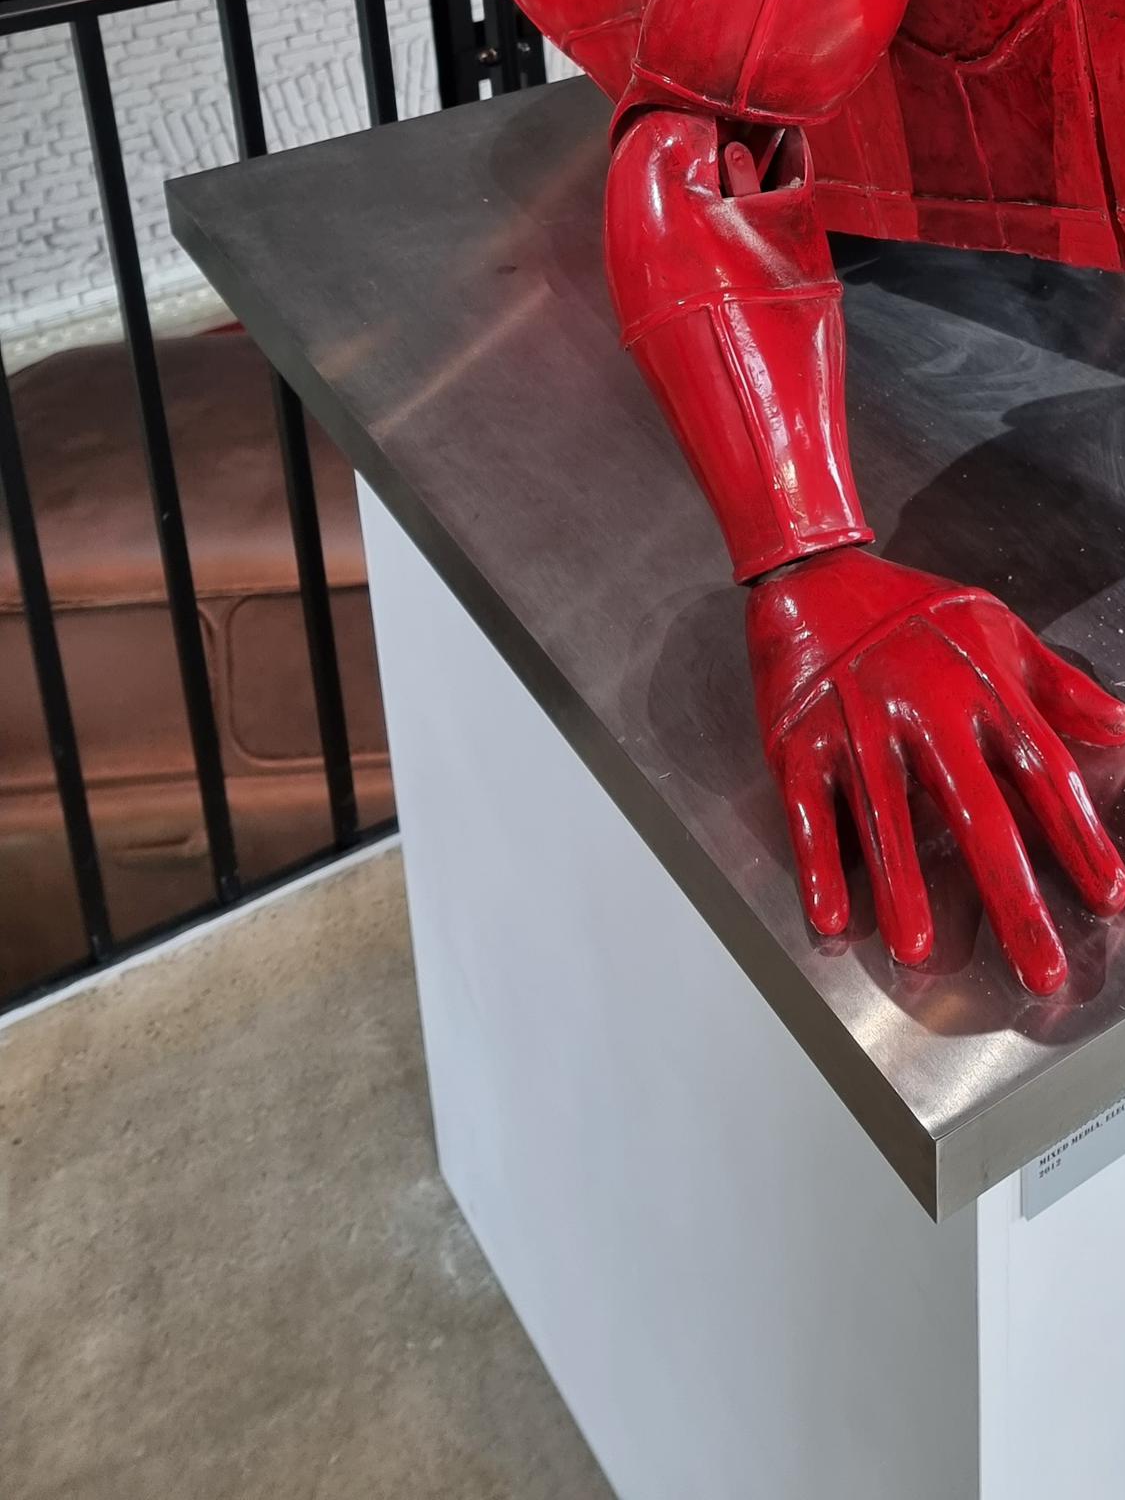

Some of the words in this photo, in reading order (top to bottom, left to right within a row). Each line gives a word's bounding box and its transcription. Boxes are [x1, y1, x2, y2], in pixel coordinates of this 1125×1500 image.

[1038, 1142, 1070, 1168] MIXED
[1070, 1120, 1104, 1146] MEDIA,
[1038, 1158, 1062, 1180] 2012
